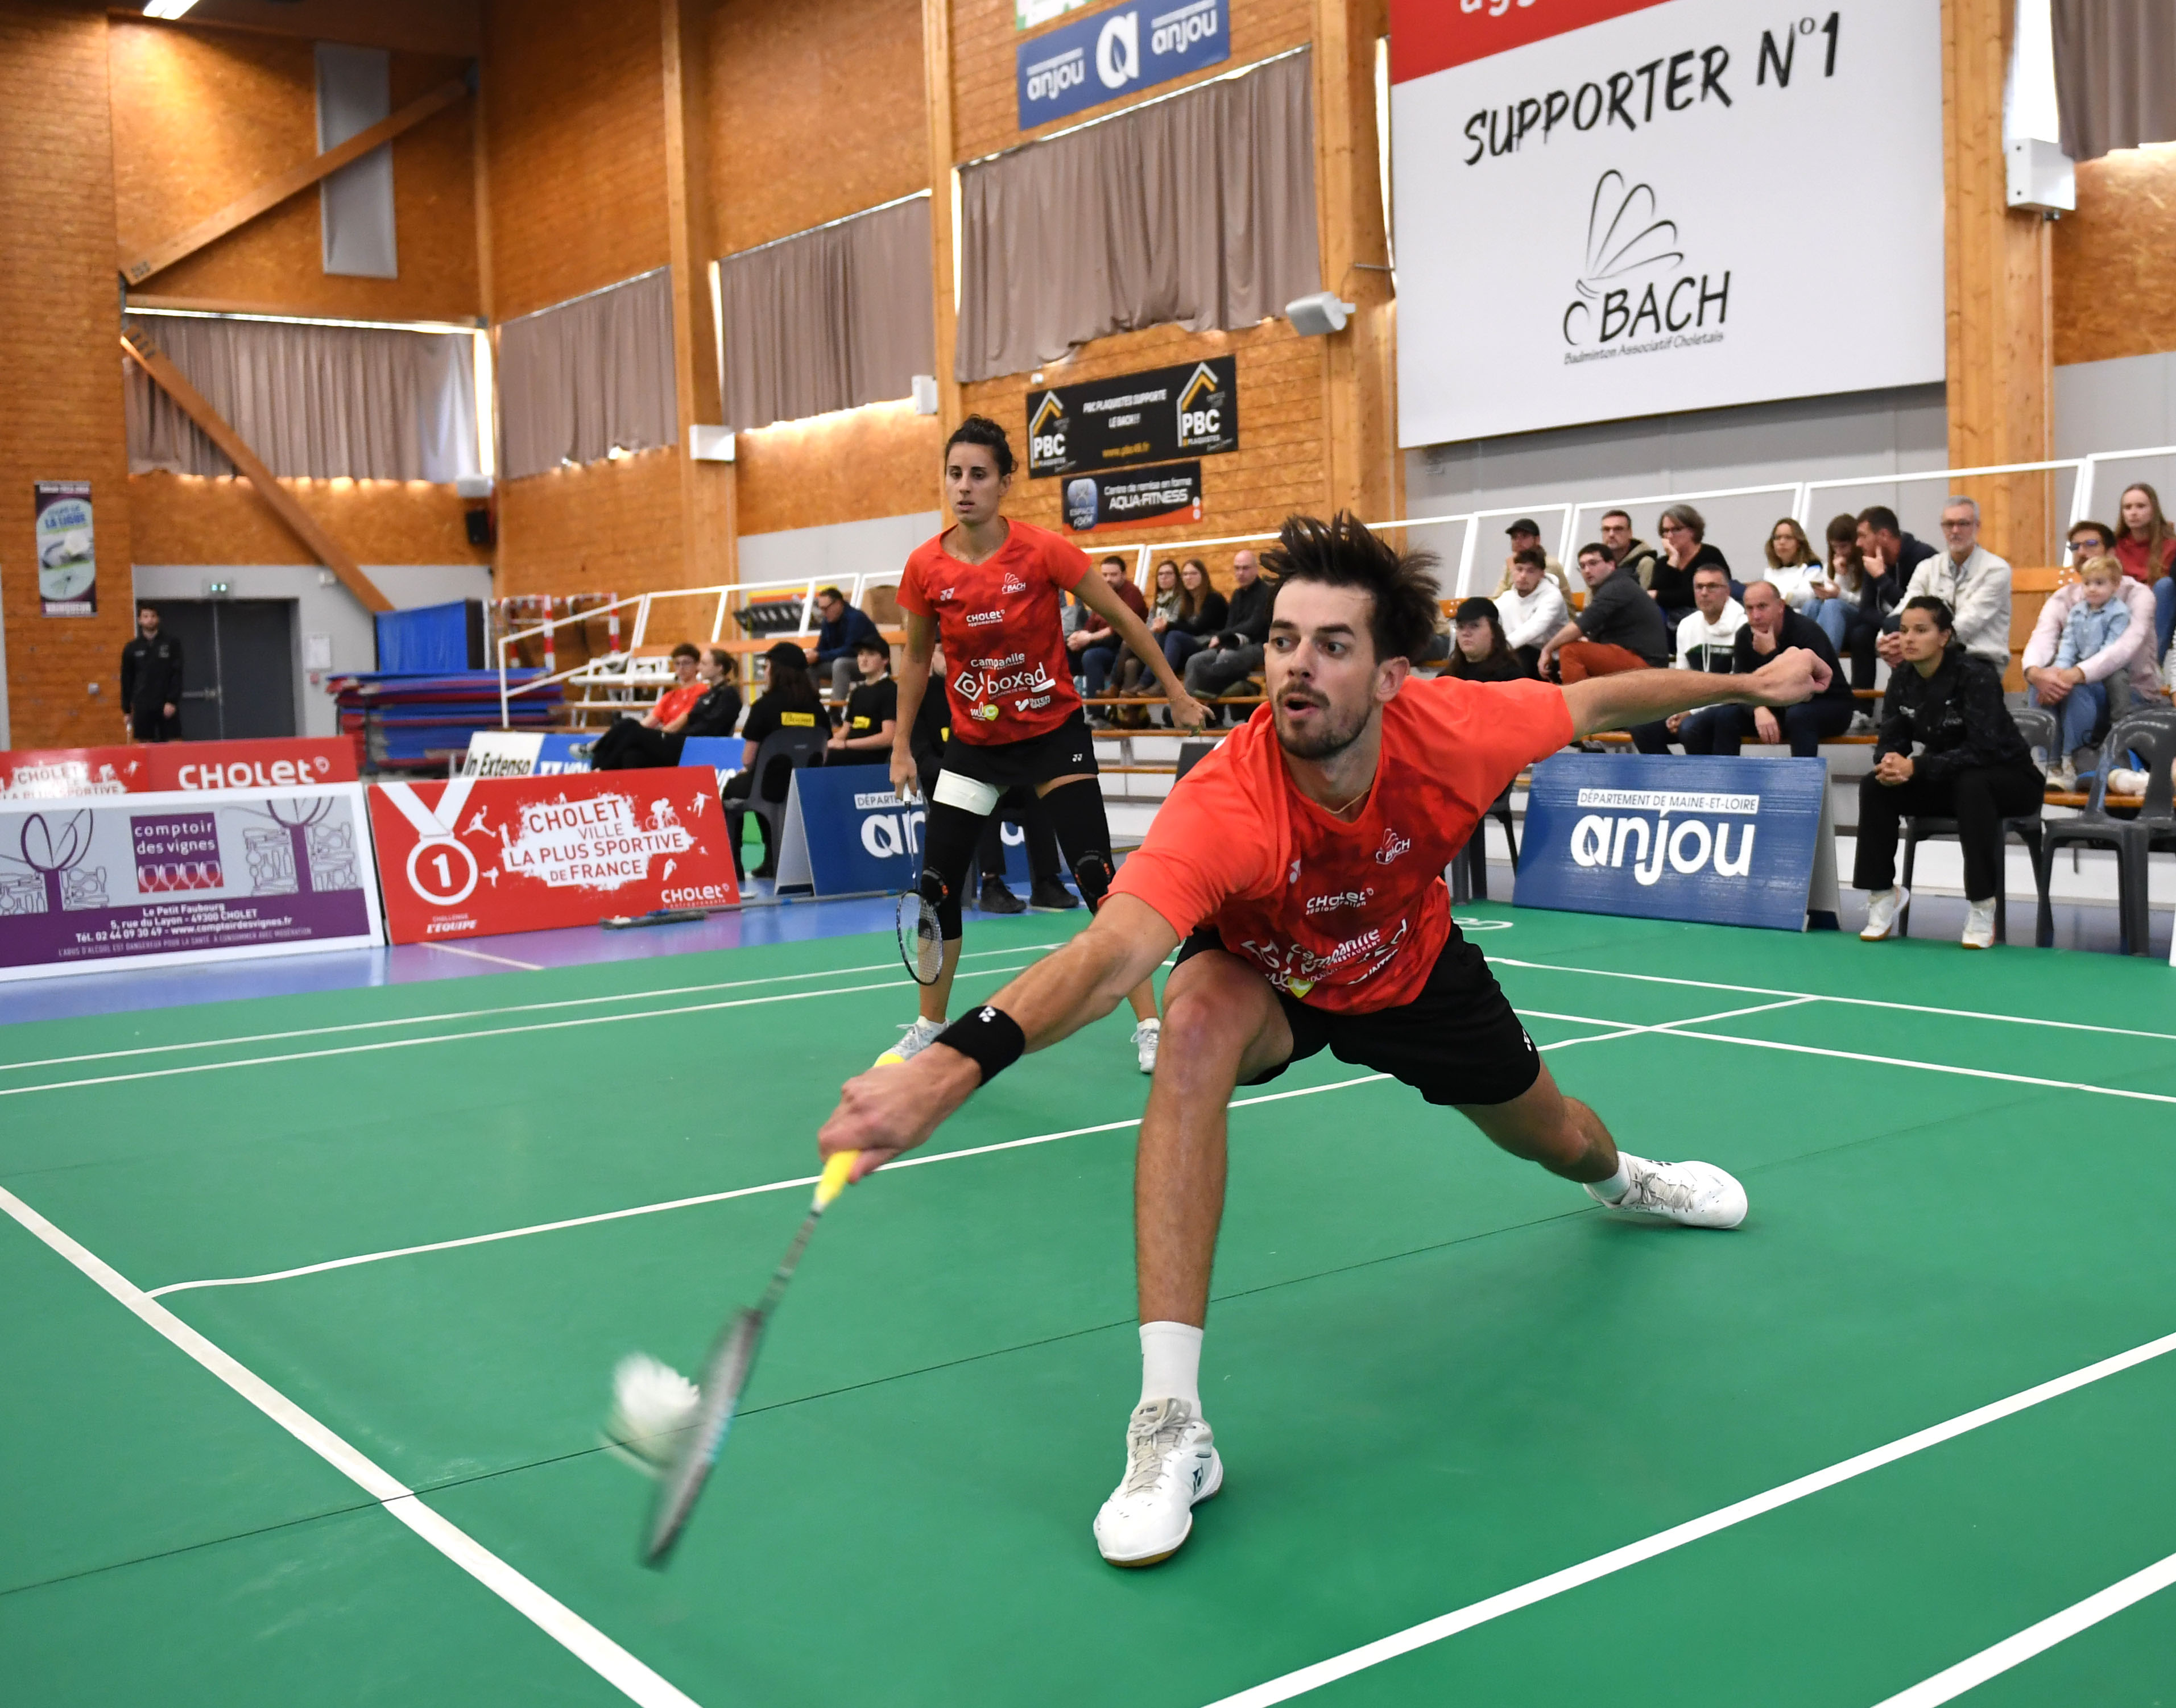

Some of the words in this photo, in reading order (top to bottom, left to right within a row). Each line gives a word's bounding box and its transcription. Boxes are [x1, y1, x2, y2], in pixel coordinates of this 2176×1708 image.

[1152, 9, 1218, 55] anjou
[1027, 60, 1085, 101] anjou
[1464, 44, 1733, 166] SUPPORTER
[1182, 409, 1221, 437] PBC
[1034, 433, 1065, 459] PBC
[987, 662, 1047, 694] boxad
[1580, 789, 1650, 805] DÉPARTEMENT
[1653, 795, 1666, 806] DE
[1669, 796, 1756, 810] MAINE-ET-LOIRE
[135, 820, 212, 838] comptoir
[528, 800, 620, 833] CHOLET
[578, 822, 624, 840] VILLE
[136, 840, 164, 855] des
[167, 838, 216, 855] vignes
[510, 850, 535, 867] LA
[540, 843, 589, 863] PLUS
[594, 833, 684, 857] SPORTIVE
[1570, 814, 1756, 886] anjou
[432, 854, 451, 887] 1
[550, 869, 566, 882] DE
[570, 859, 643, 880] FRANCE
[121, 920, 139, 929] rue
[140, 918, 153, 927] du
[155, 916, 183, 927] Layon
[191, 912, 219, 923] 49300
[221, 908, 258, 920] CHOLET
[156, 905, 180, 916] Petit
[181, 903, 226, 915] Faubourg
[96, 931, 108, 941] 02
[123, 928, 135, 938] 09
[151, 927, 162, 937] 49
[171, 916, 292, 935] www.comptoirdesvignes.fr
